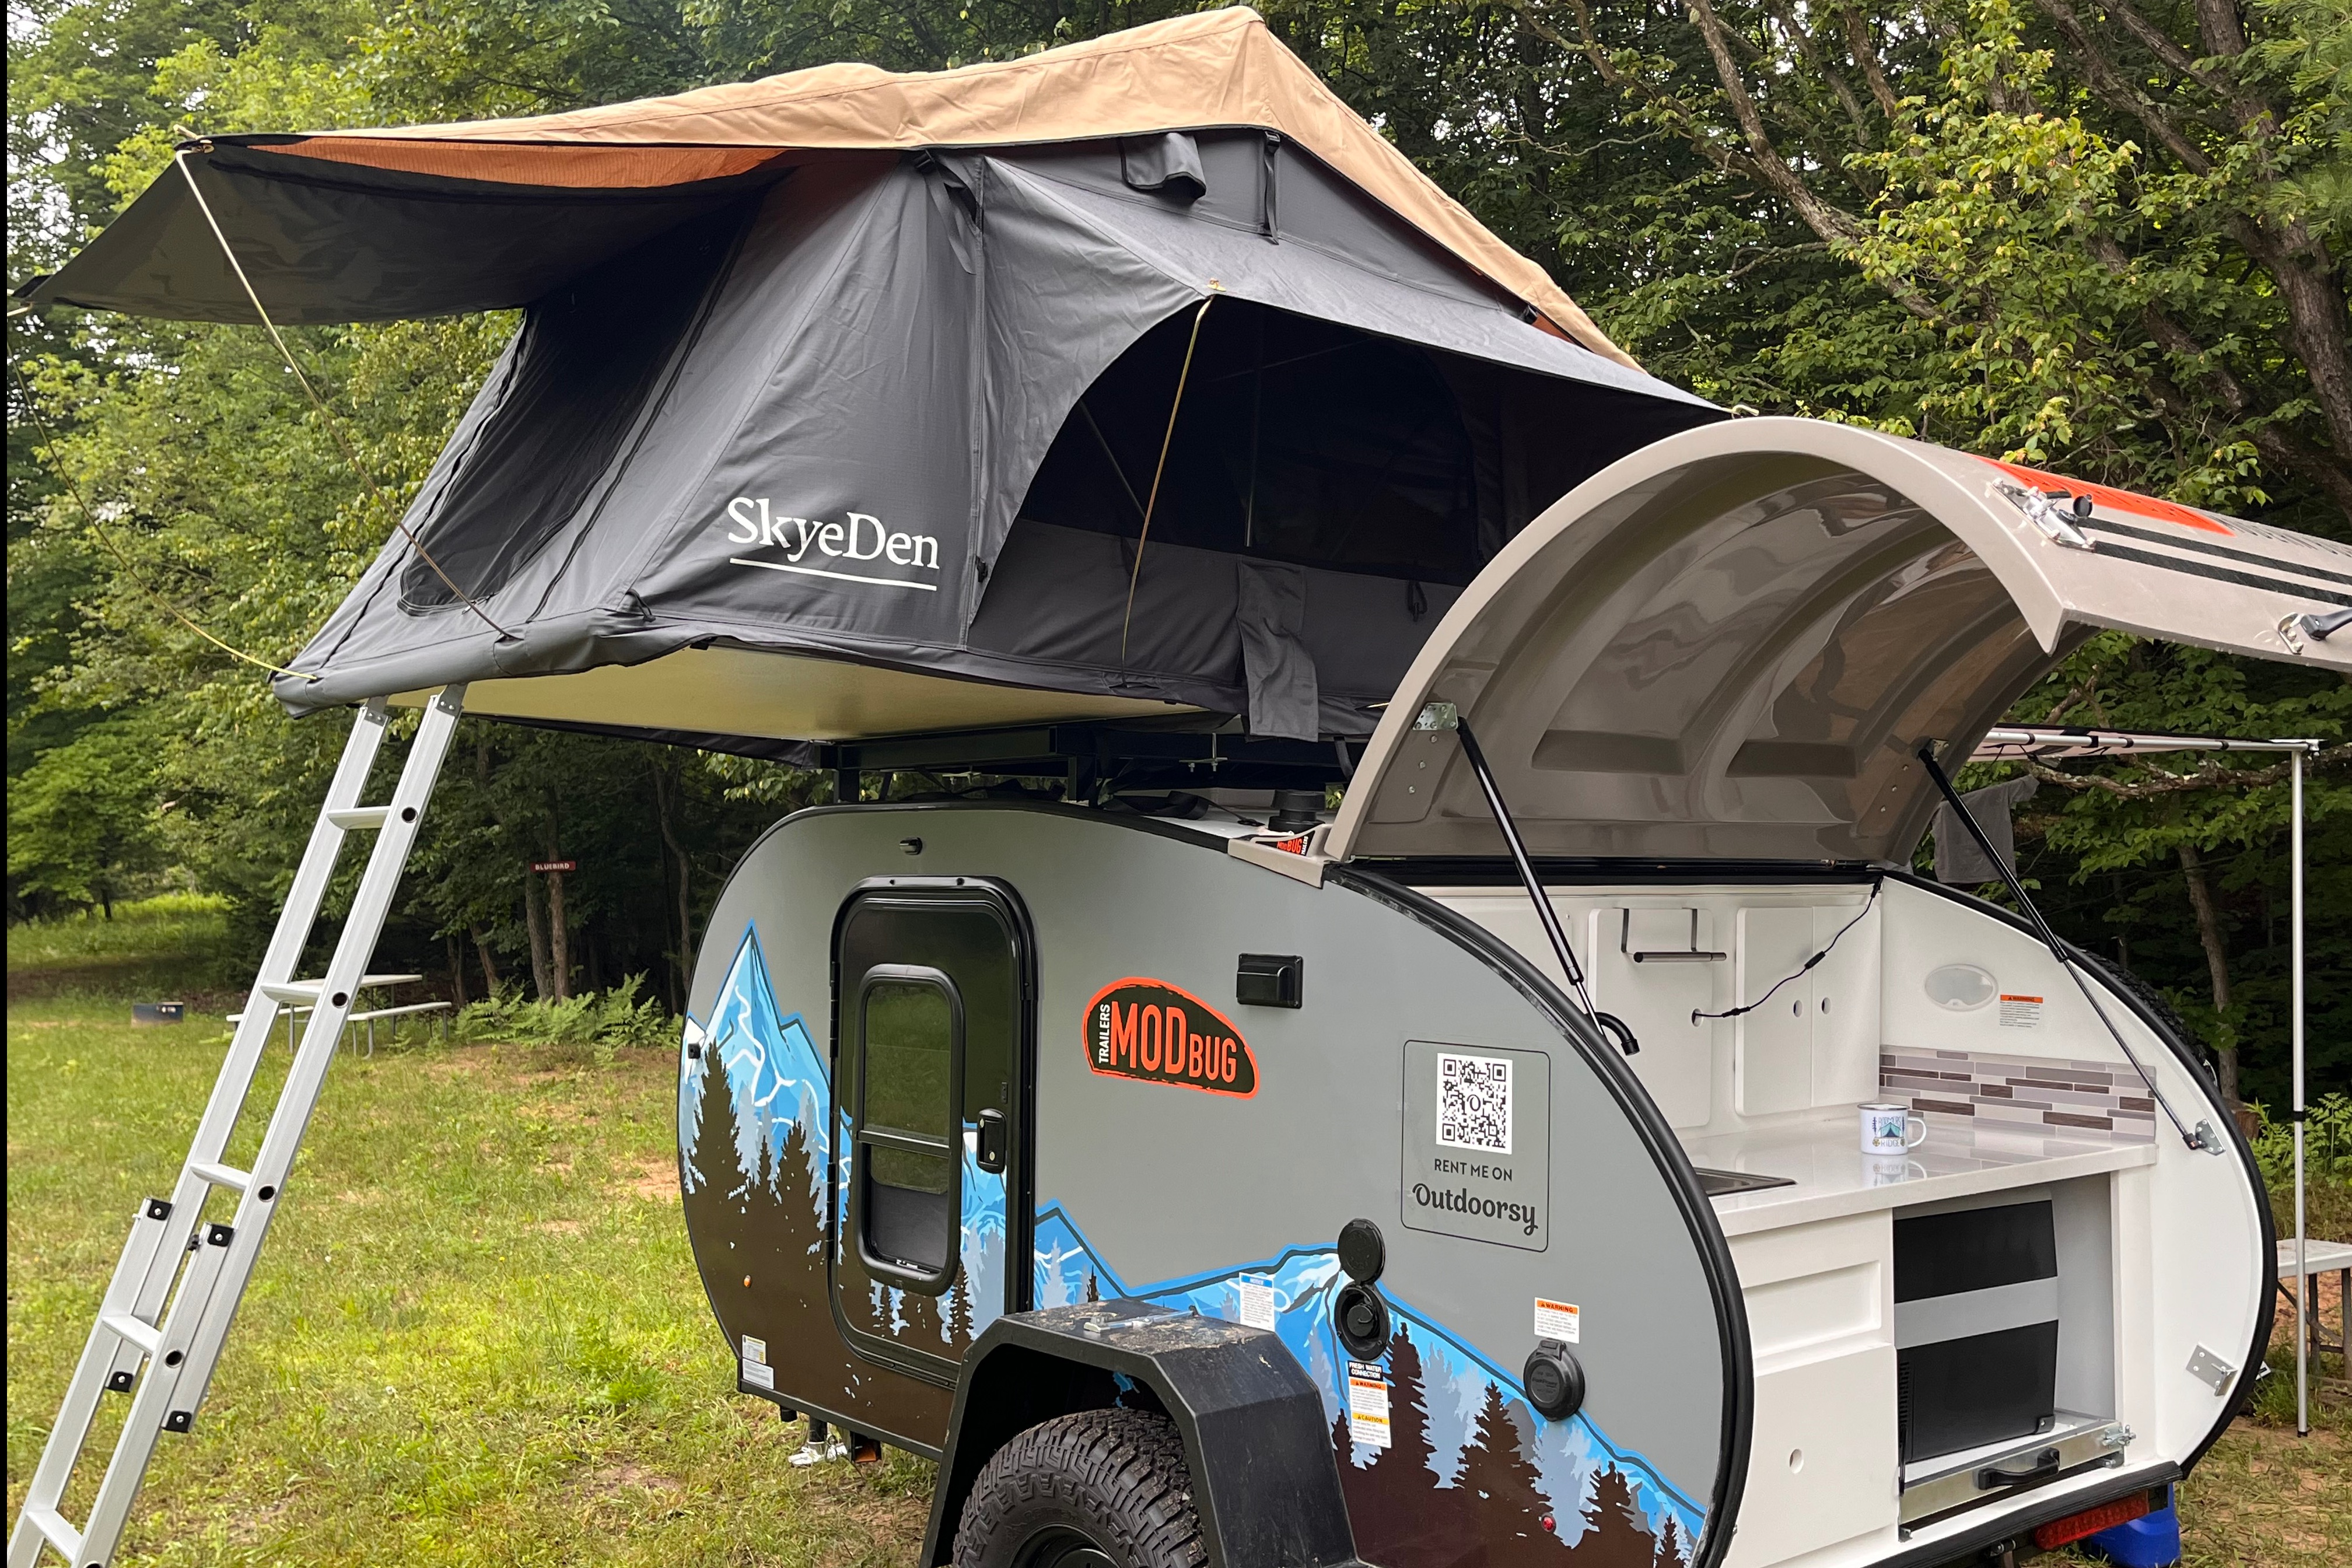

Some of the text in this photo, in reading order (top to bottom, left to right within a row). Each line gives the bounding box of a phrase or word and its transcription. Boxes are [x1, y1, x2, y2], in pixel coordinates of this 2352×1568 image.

[727, 497, 940, 570] SkyeDen
[535, 862, 570, 870] BLUEBIRD
[1098, 1003, 1111, 1064] TRAILERS
[1434, 1158, 1513, 1182] RENT ME ON
[1412, 1182, 1539, 1236] Outdoorsy
[1546, 1303, 1573, 1313] WARNING
[1349, 1362, 1382, 1373] FRESH WATER
[1351, 1369, 1381, 1379] CONNECTION
[1362, 1415, 1383, 1424] CAUTION
